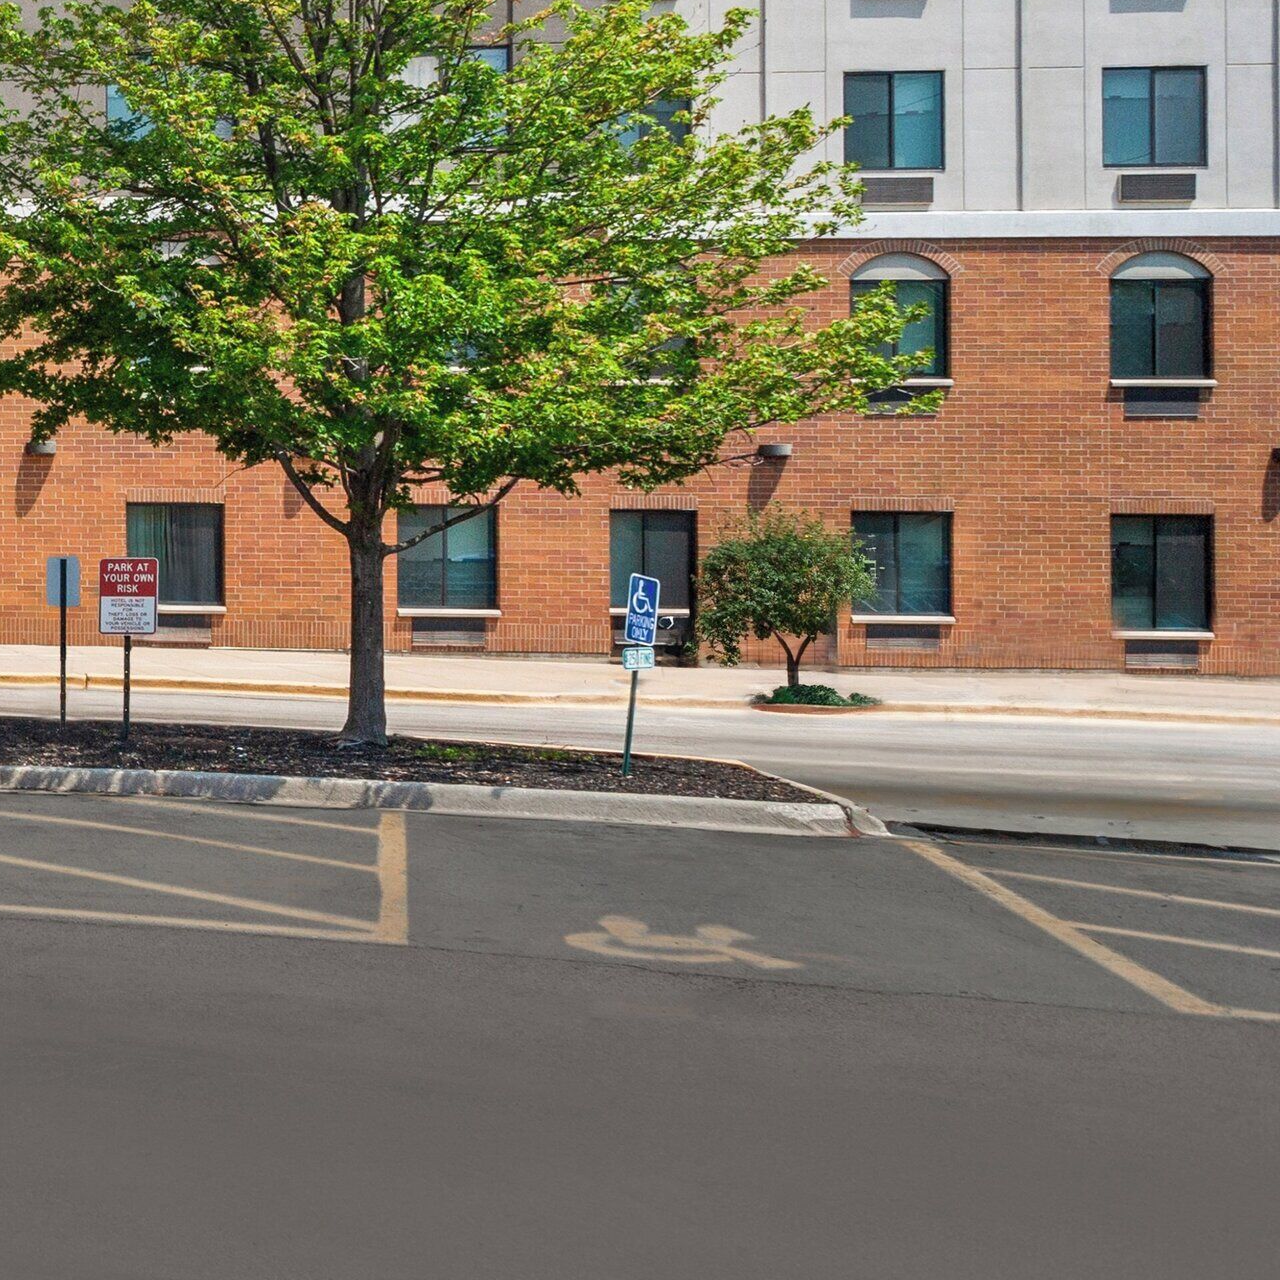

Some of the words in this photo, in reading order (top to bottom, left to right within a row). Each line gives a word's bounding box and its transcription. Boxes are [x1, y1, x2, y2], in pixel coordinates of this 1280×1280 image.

[108, 563, 133, 571] PARK
[137, 563, 149, 571] AT
[103, 573, 130, 582] YOUR
[133, 573, 154, 582] OWN
[117, 584, 139, 593] RISK
[629, 612, 654, 630] PARKING
[631, 626, 649, 641] ONLY
